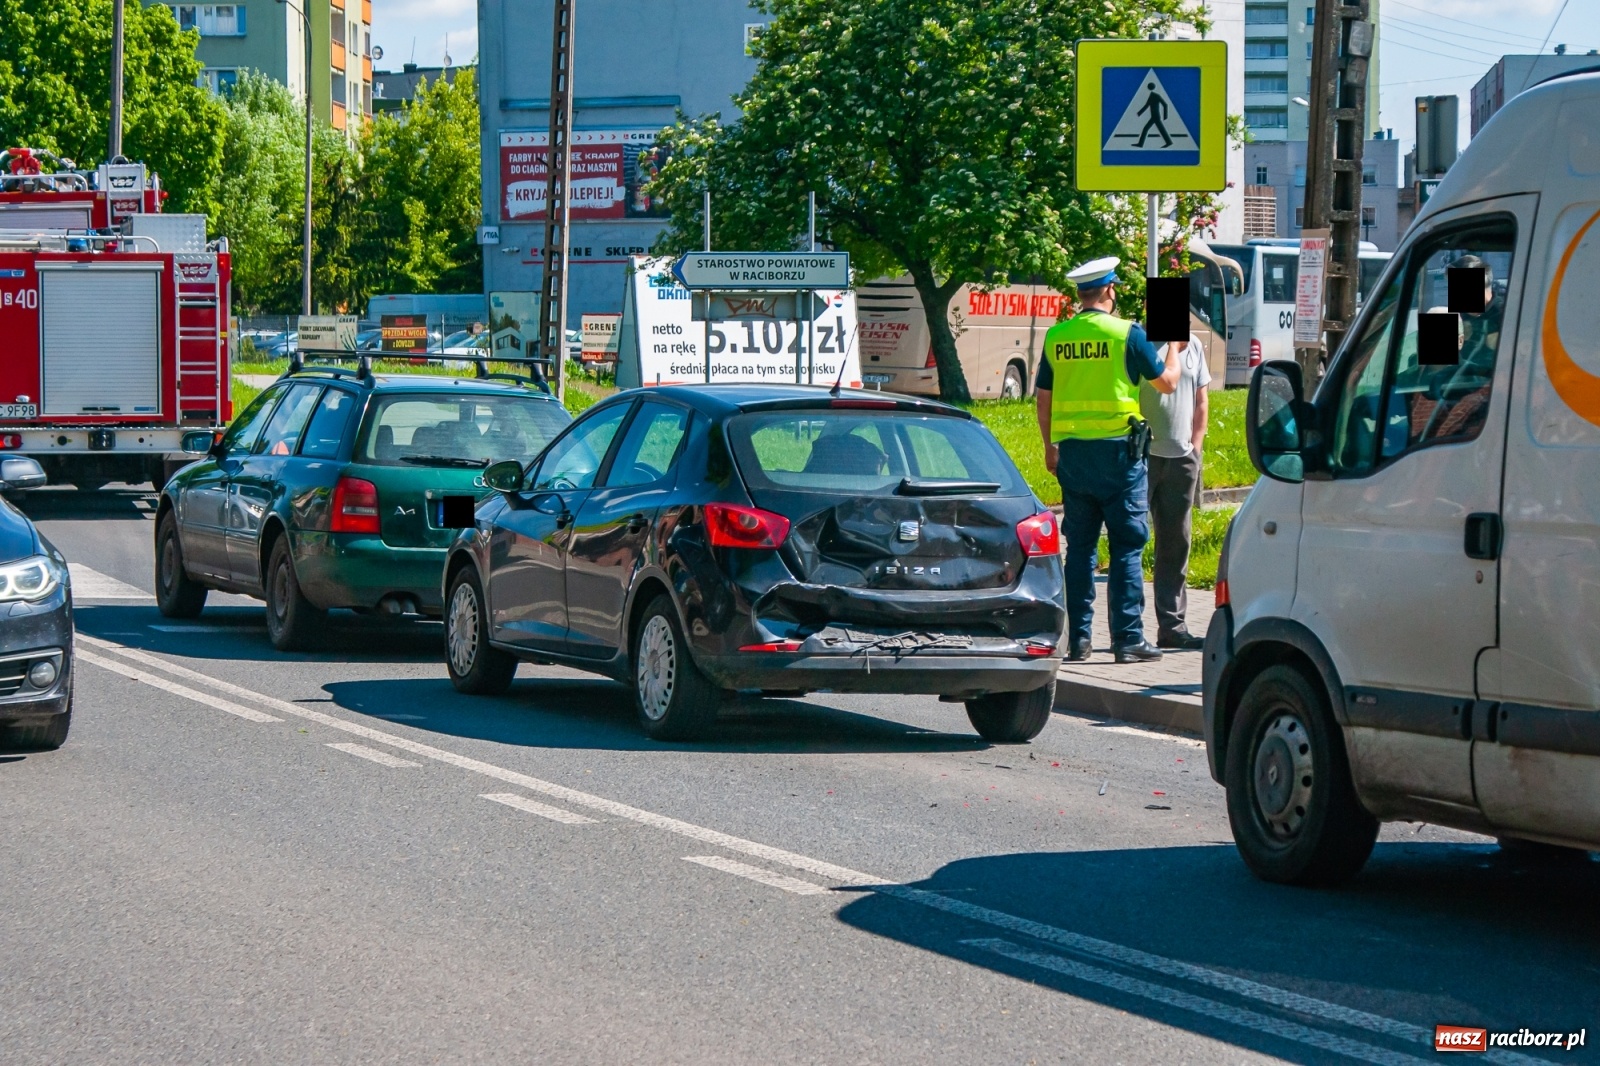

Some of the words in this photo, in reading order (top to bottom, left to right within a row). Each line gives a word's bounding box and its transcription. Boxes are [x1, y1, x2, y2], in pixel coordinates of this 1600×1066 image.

[509, 153, 532, 162] FARBY
[585, 152, 619, 160] KRAMP
[511, 166, 521, 174] DO
[570, 163, 586, 172] RAZ
[588, 161, 617, 172] MASZYN
[697, 259, 765, 269] STAROSTWO
[767, 258, 835, 269] POWIATOWE
[729, 271, 740, 281] W
[742, 271, 805, 281] RACIBORZU
[15, 289, 38, 310] 40
[589, 323, 617, 331] GRENE
[652, 324, 683, 335] netto
[817, 316, 846, 354] zł
[860, 331, 902, 339] EISEN
[653, 344, 667, 354] na
[671, 341, 696, 356] rękę
[1055, 341, 1109, 361] POLICJA
[711, 363, 738, 377] płaca
[742, 365, 753, 374] na
[756, 364, 776, 377] tym
[8, 406, 35, 418] 9F98
[875, 566, 941, 575] IBIZA
